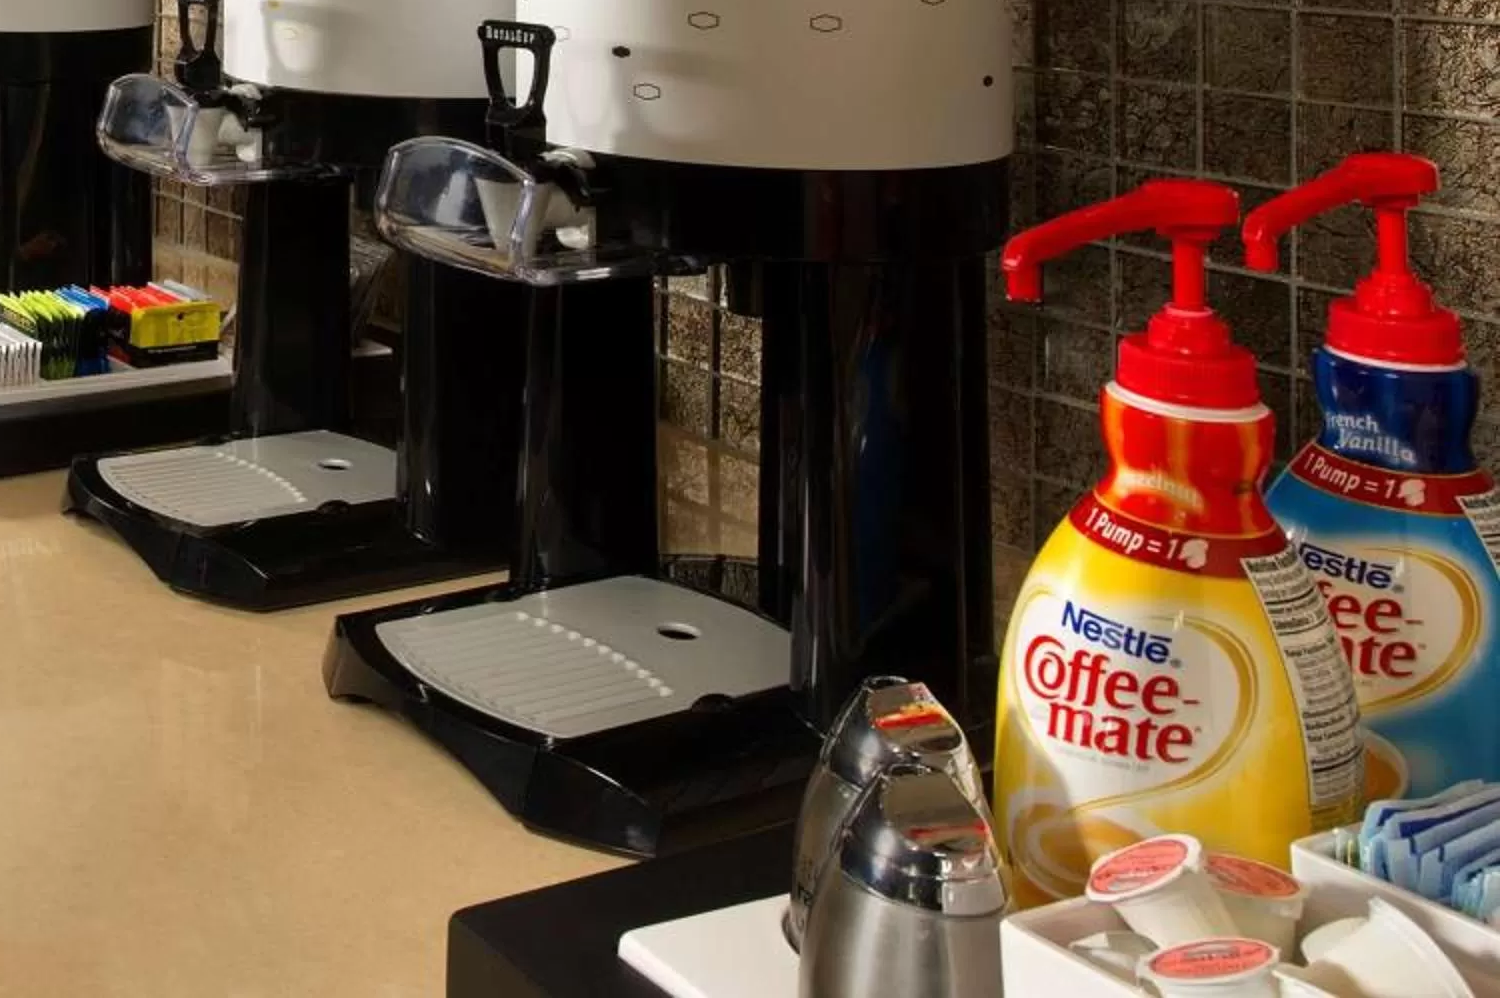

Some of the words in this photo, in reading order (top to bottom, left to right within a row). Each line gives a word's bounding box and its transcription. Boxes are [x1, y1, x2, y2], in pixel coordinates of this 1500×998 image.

[1338, 429, 1418, 464] Vanilla
[1303, 453, 1315, 470] 1
[1311, 457, 1361, 493] Pump
[1384, 479, 1397, 499] 1
[1084, 507, 1099, 527] 1
[1092, 511, 1145, 555] Pump
[1166, 538, 1178, 560] 1
[1047, 702, 1193, 764] mate
